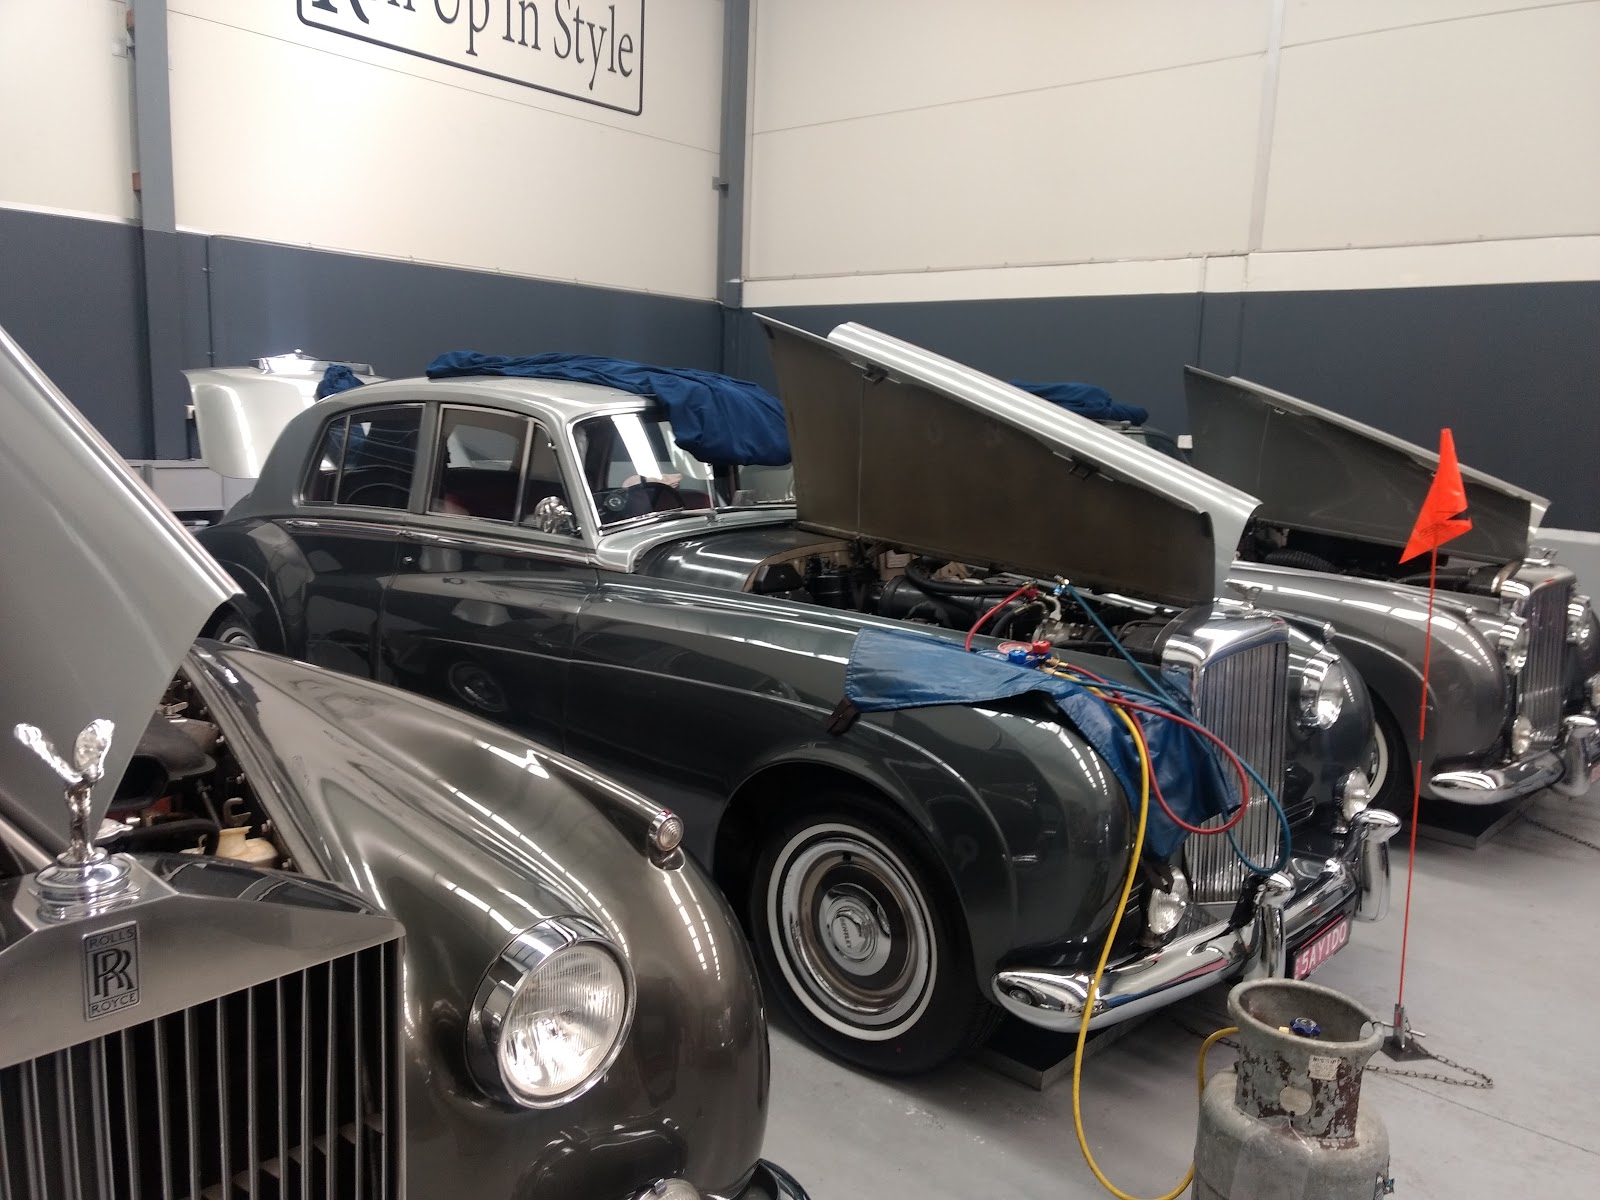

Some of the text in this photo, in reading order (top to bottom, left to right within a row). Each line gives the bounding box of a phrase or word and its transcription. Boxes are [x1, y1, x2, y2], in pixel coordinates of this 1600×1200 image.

[553, 0, 634, 91] Style
[89, 928, 134, 948] ROLLS
[840, 917, 852, 949] BENTLEY
[91, 992, 136, 1015] ROYCE
